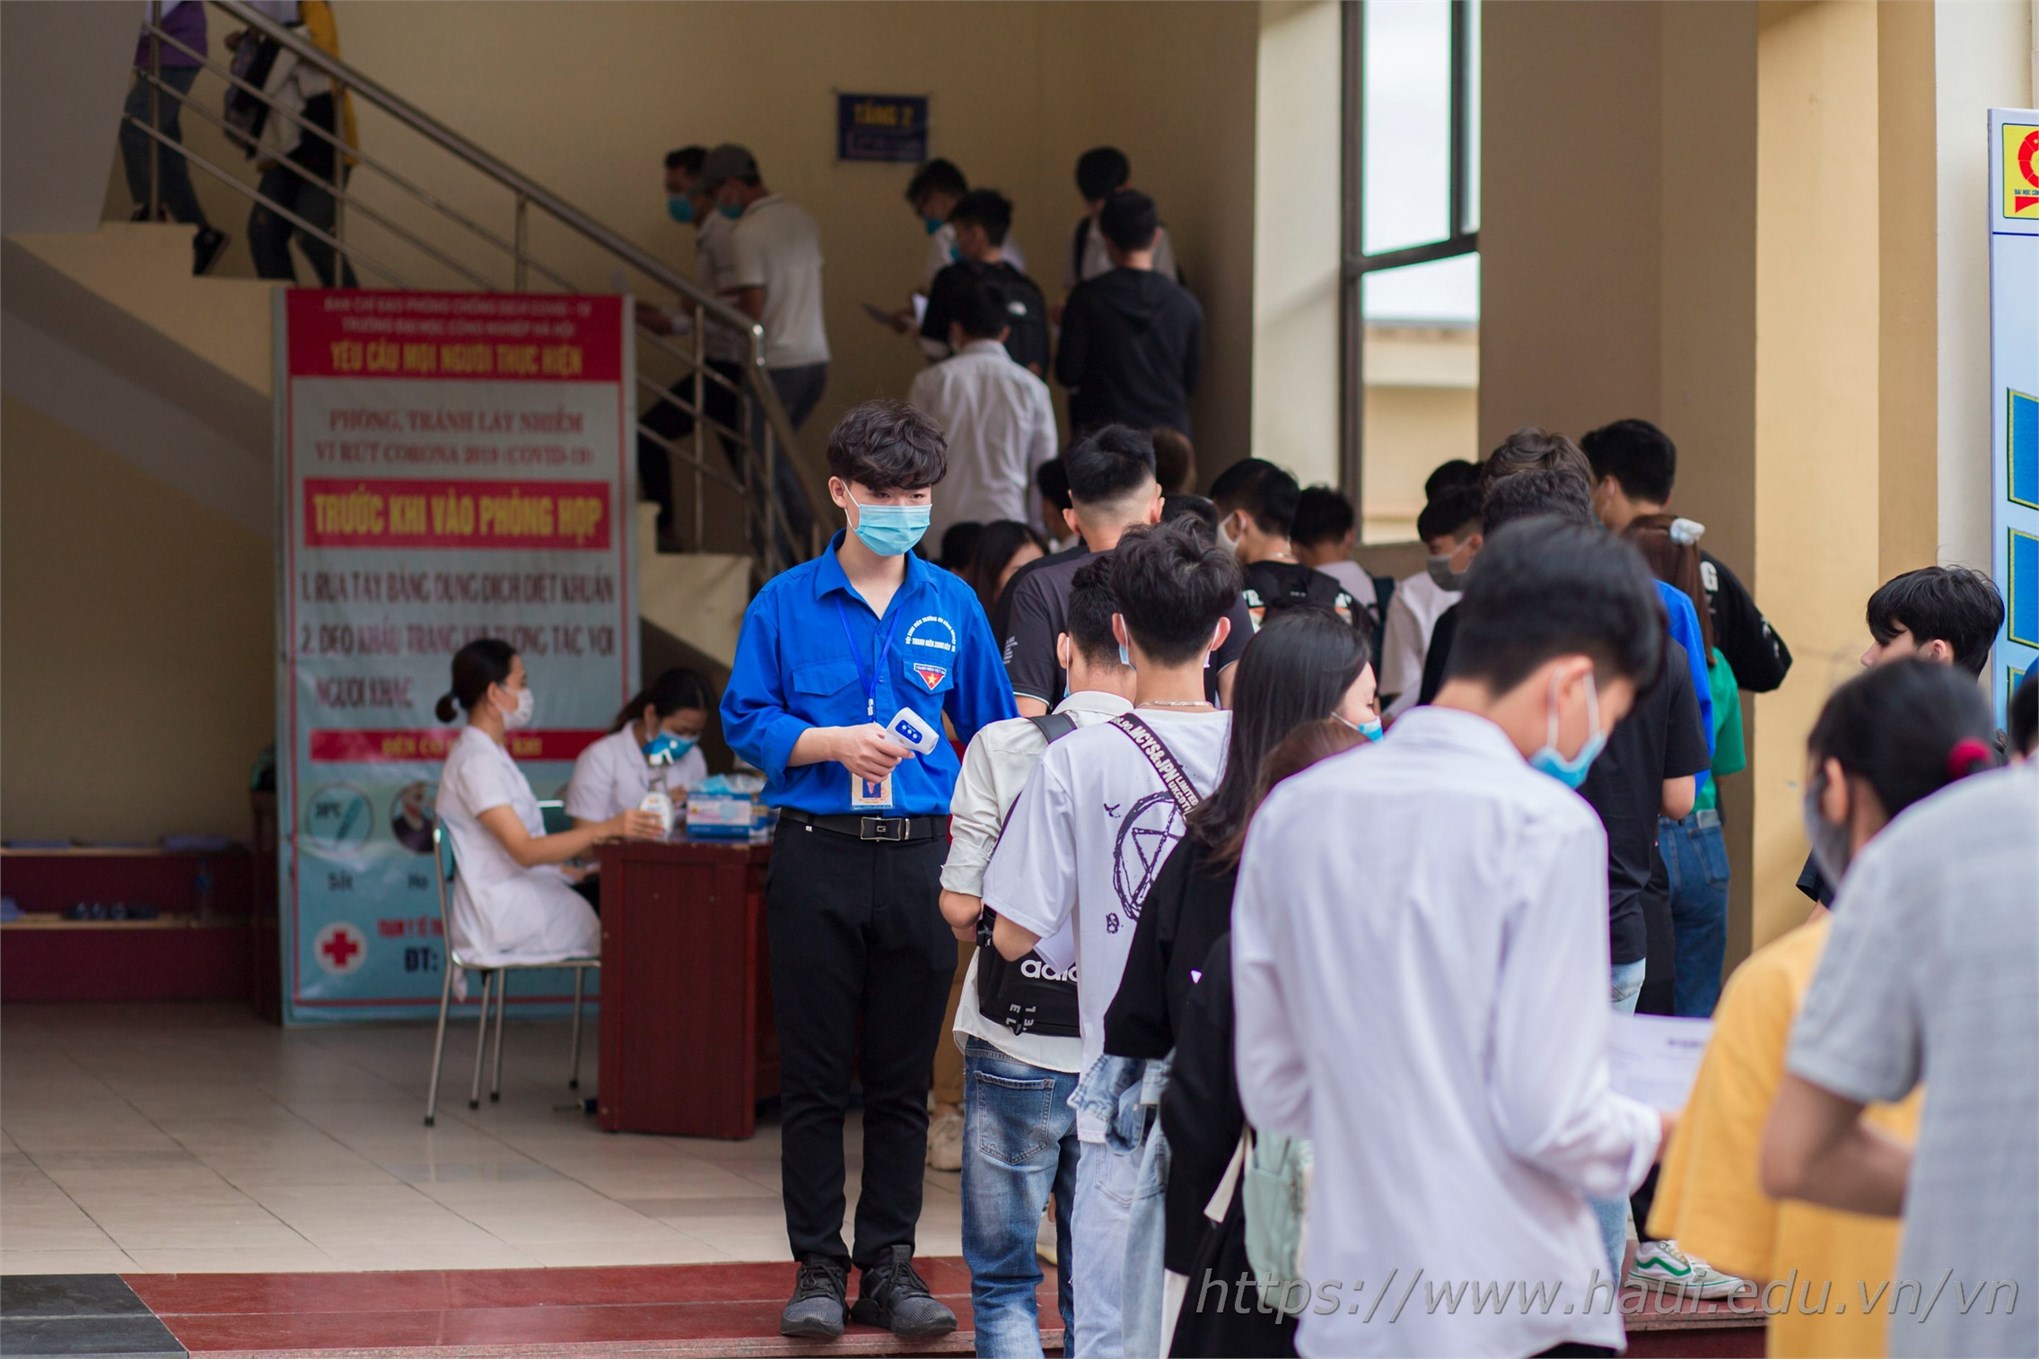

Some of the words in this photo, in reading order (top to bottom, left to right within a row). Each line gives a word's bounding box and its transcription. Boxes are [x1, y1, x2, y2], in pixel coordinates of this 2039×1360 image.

[313, 483, 384, 535] TRƯỚC
[389, 496, 426, 535] KHI
[431, 487, 474, 535] VÀO
[479, 487, 553, 536] PHÒNG
[558, 497, 602, 545] HỌP
